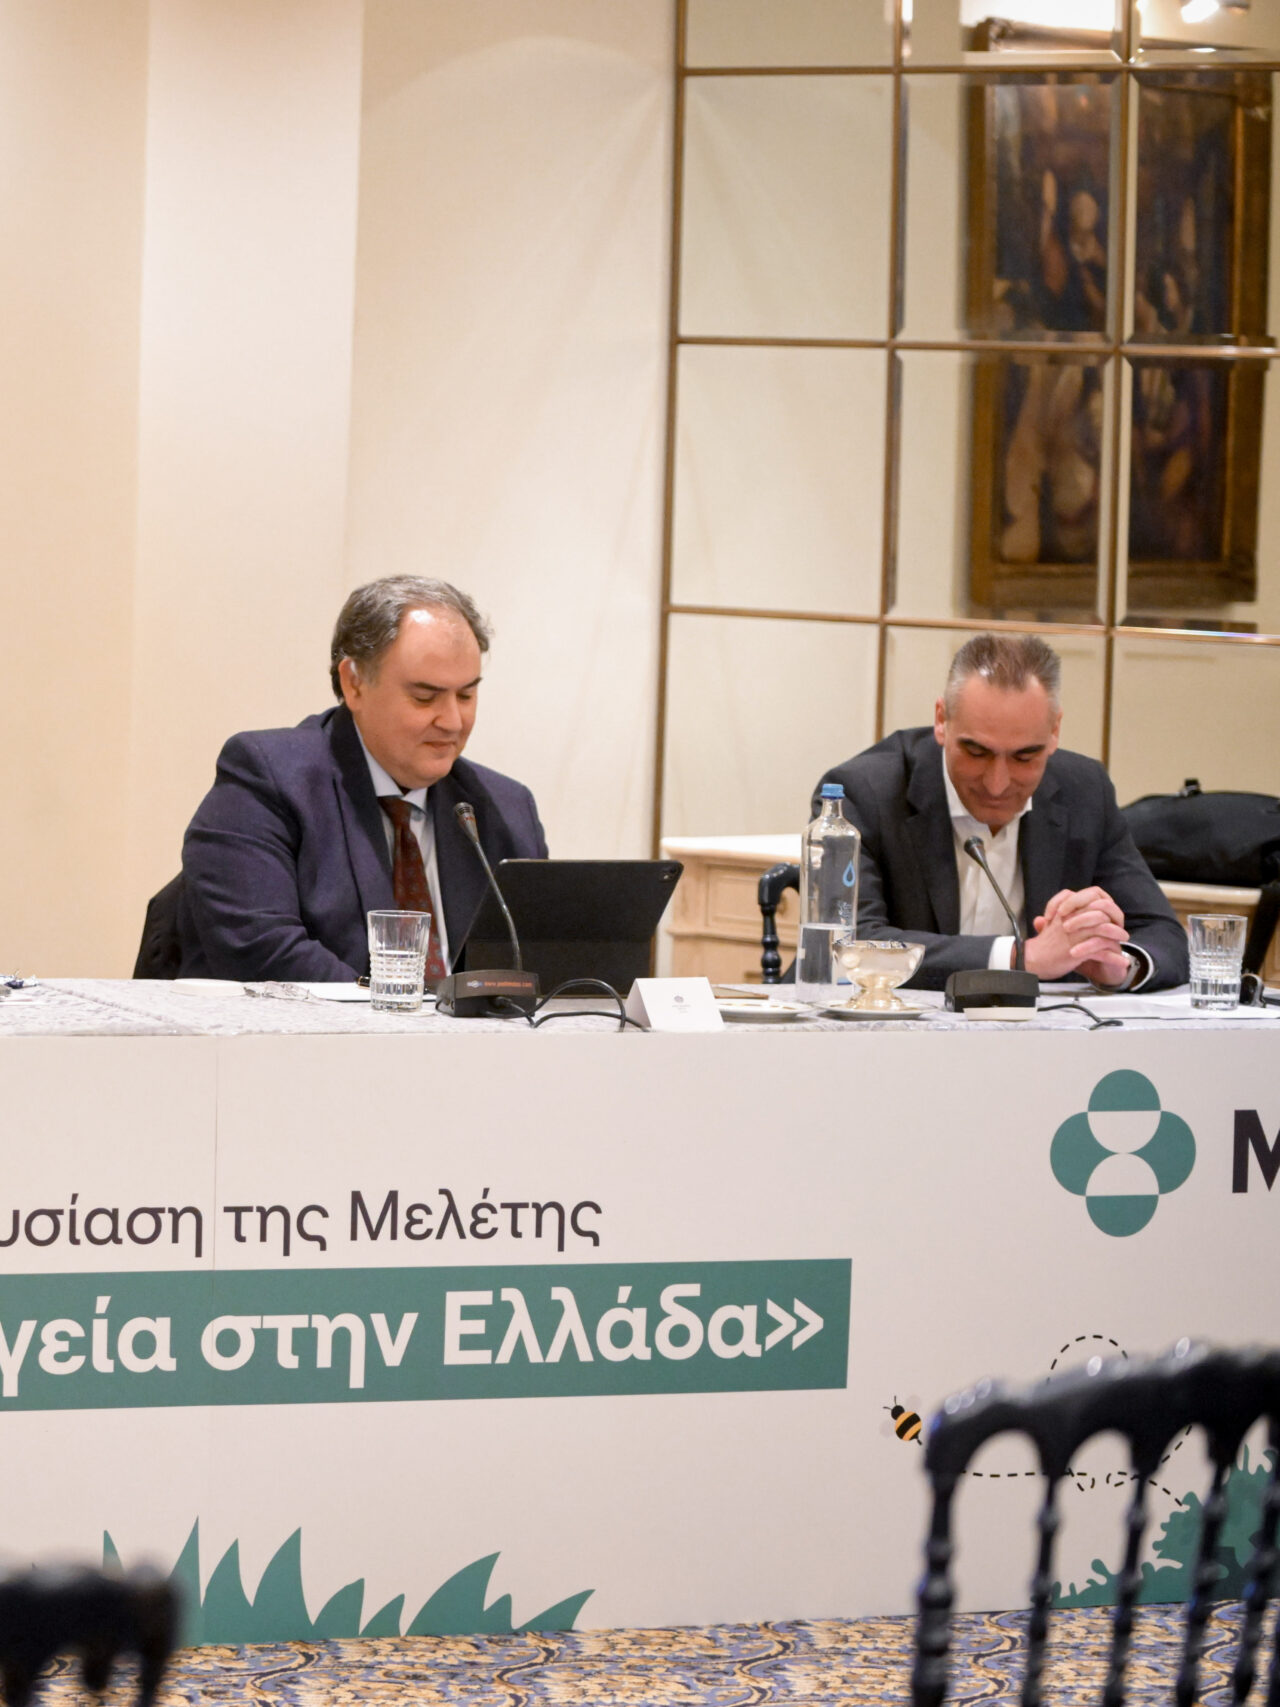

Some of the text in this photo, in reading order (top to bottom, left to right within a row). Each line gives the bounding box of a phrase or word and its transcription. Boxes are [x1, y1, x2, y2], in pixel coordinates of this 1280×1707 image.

[223, 1204, 329, 1257] της
[350, 1187, 602, 1252] Μελέτης
[200, 1311, 419, 1389] στην
[443, 1283, 824, 1366] Ελλάδα»
